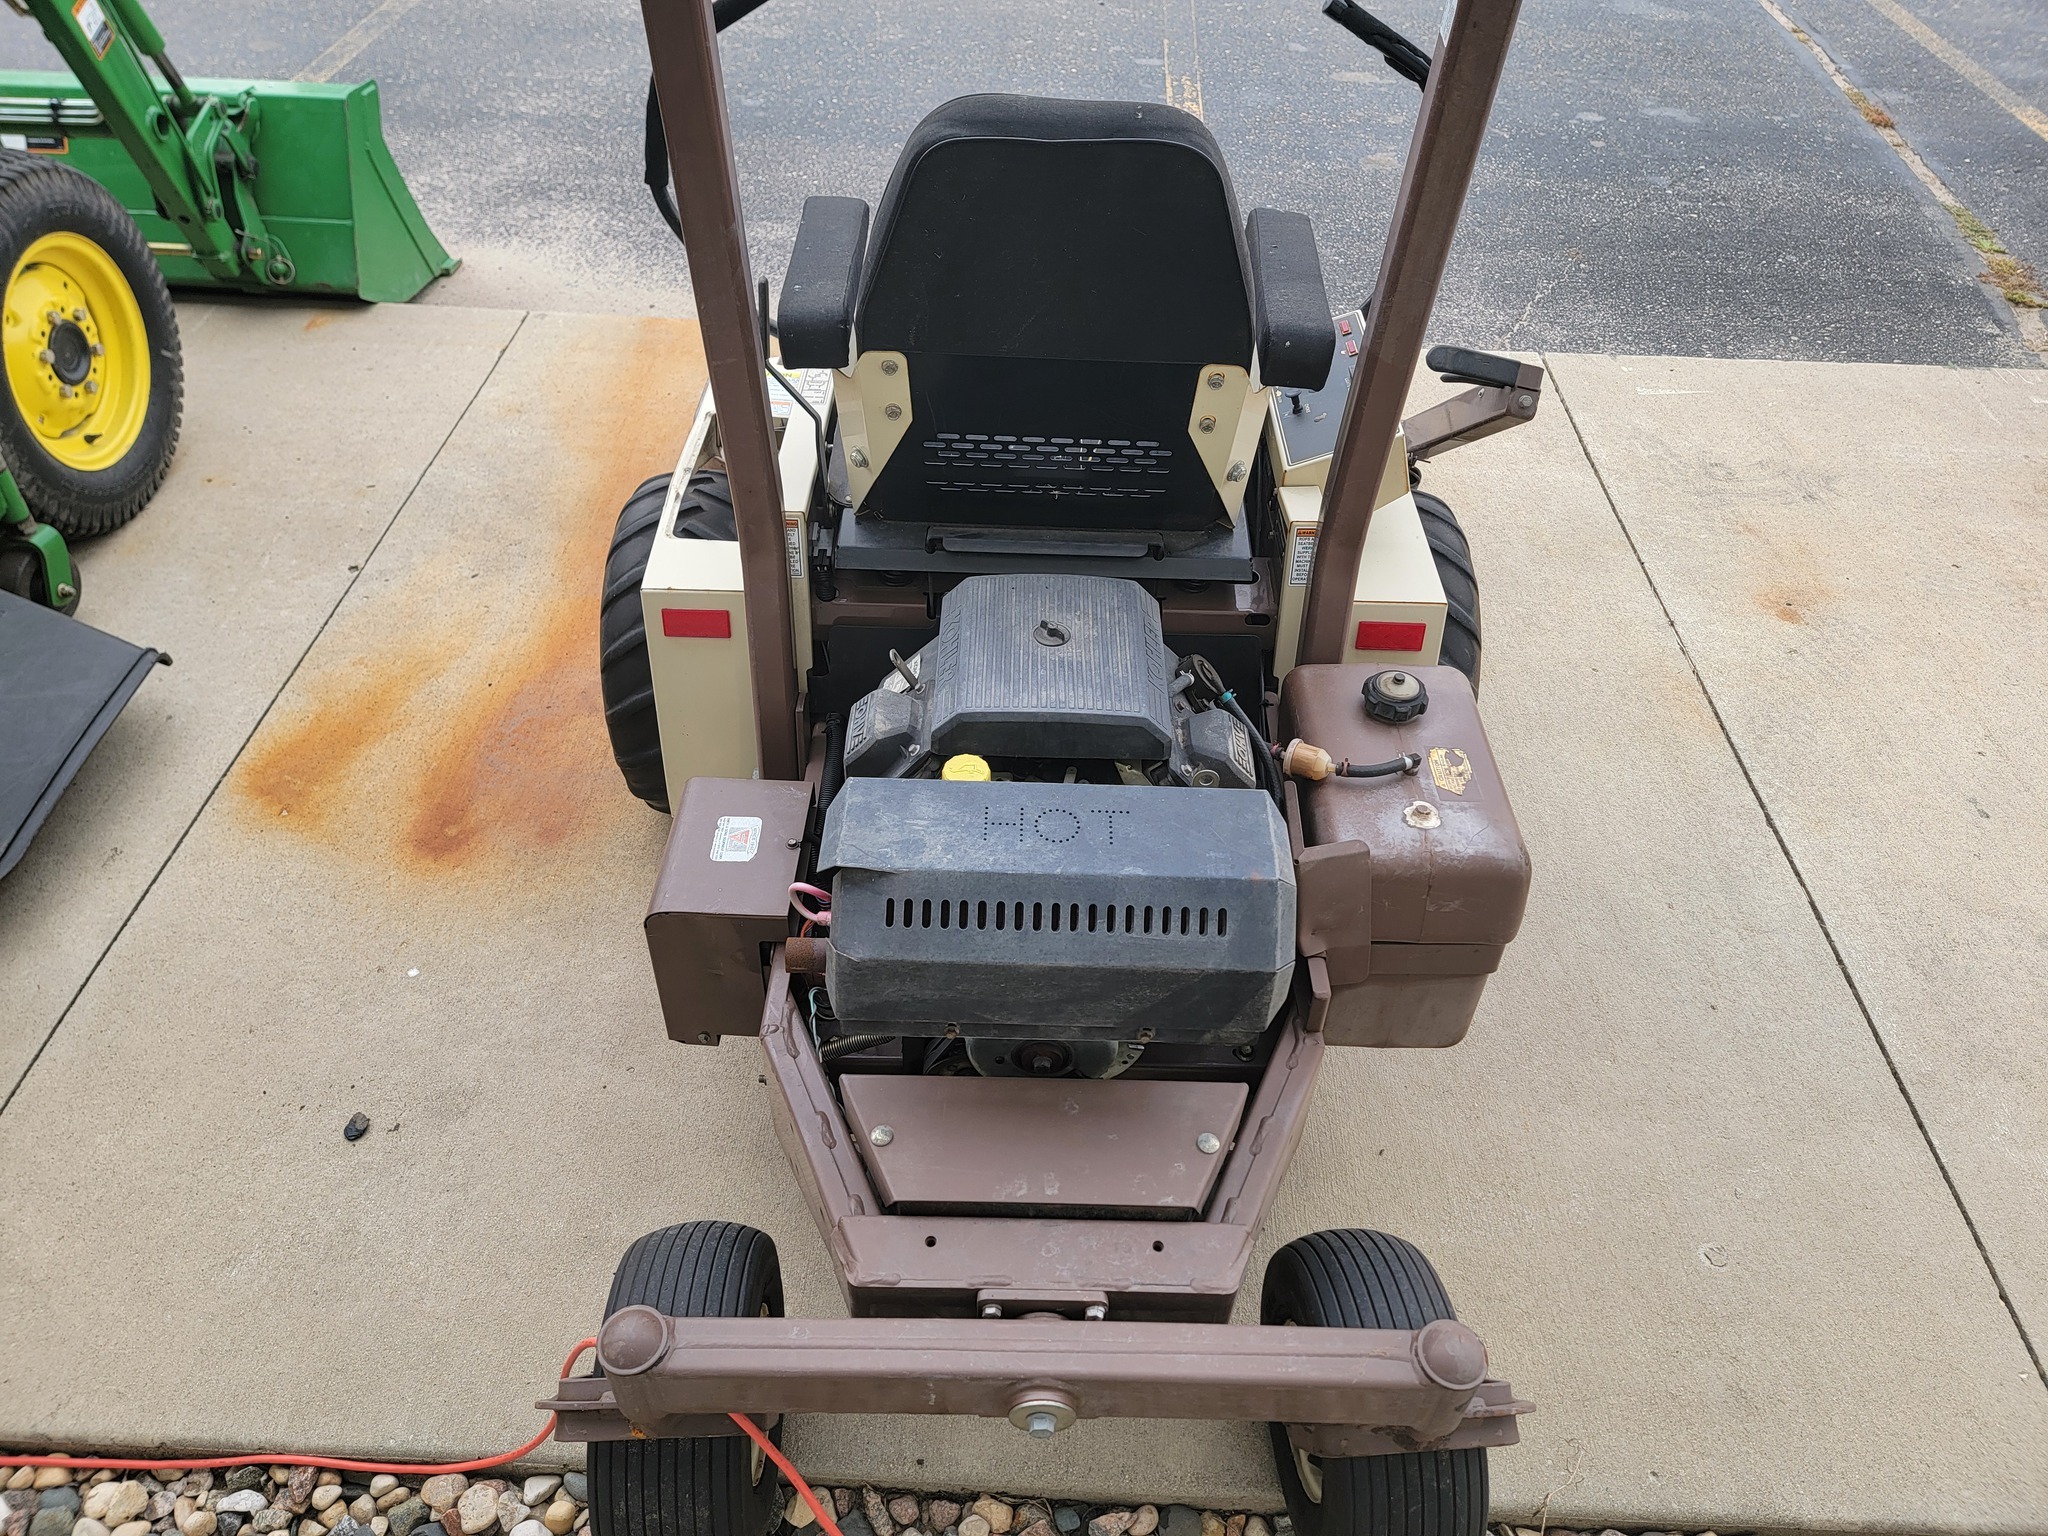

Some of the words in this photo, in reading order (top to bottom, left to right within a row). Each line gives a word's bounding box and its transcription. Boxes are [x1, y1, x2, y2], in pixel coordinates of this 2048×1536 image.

[938, 605, 962, 692] KOHLER
[1143, 611, 1165, 695] KOHLER
[982, 805, 1131, 846] HOT
